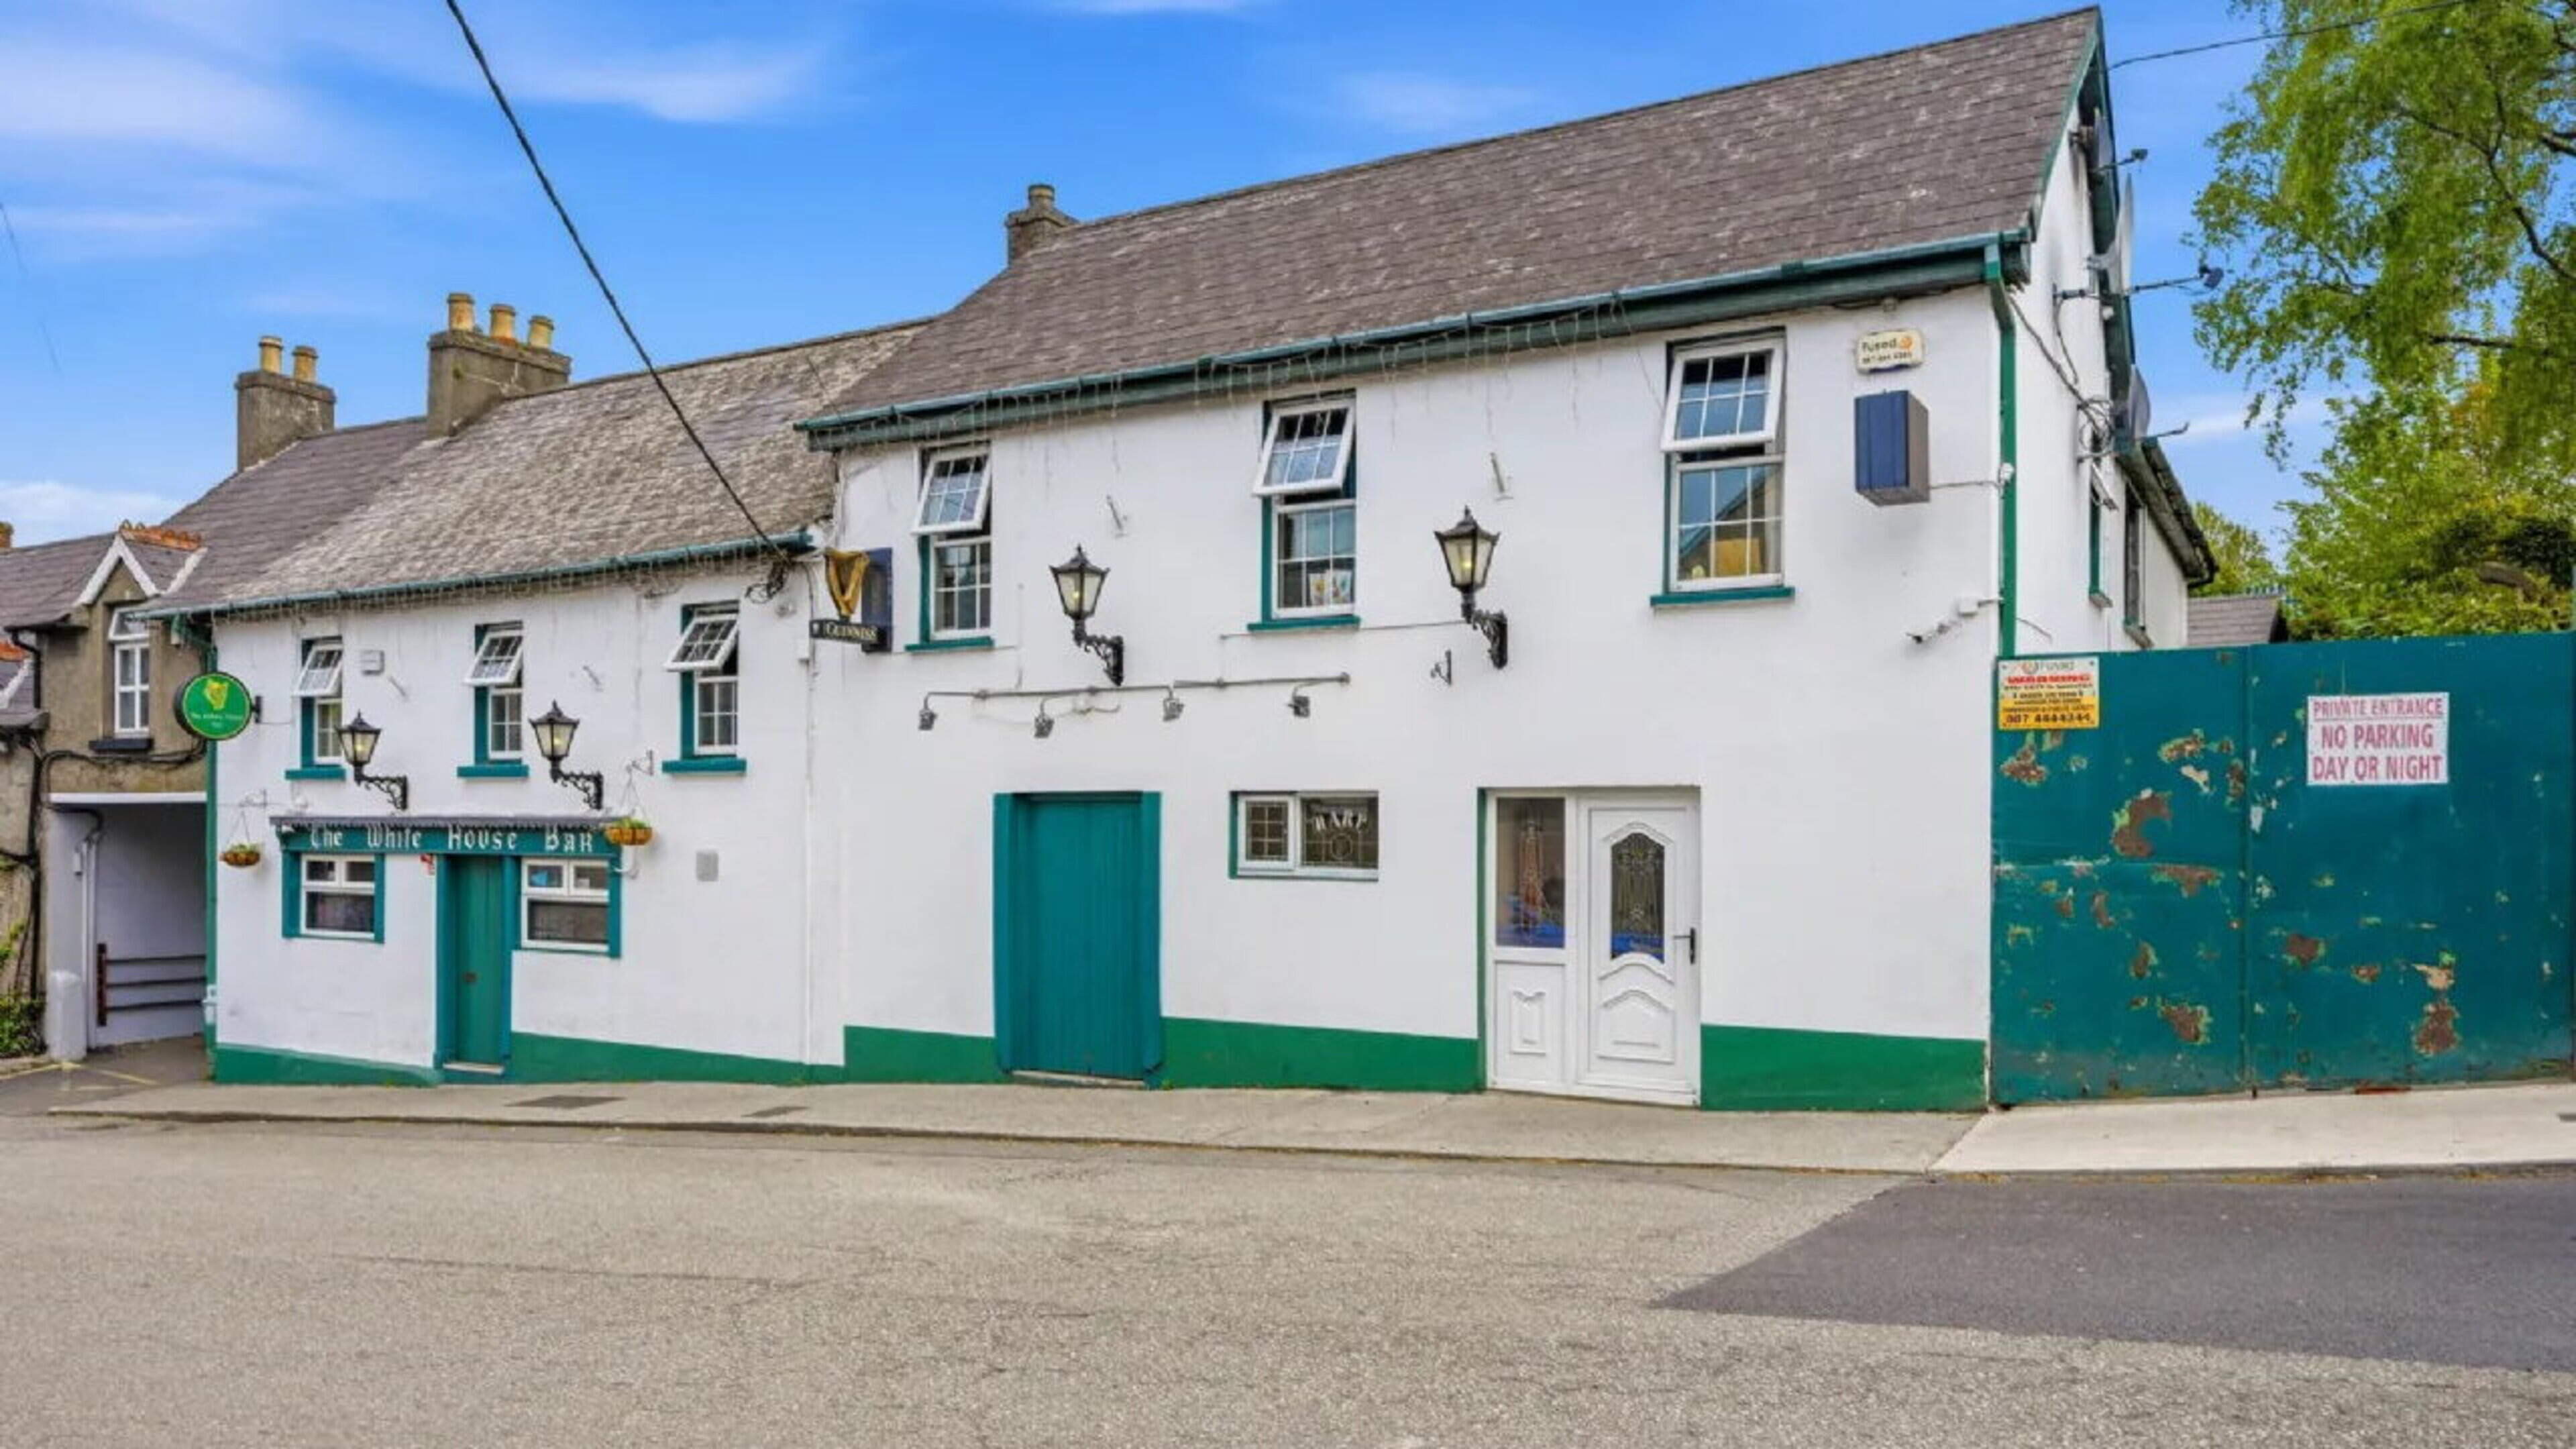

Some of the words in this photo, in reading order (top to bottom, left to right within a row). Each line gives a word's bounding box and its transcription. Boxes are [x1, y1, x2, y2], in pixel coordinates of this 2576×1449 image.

[826, 622, 877, 641] GUINNESS
[2313, 700, 2367, 717] PRIVATE
[2371, 698, 2443, 716] ENTRANCE
[2321, 724, 2347, 749] NO
[2354, 724, 2434, 749] PARKING
[2312, 756, 2349, 781] DAY
[2354, 756, 2378, 781] OR
[2386, 755, 2443, 780] NIGHT
[311, 823, 343, 848] The
[367, 824, 422, 849] White
[447, 824, 517, 850] House
